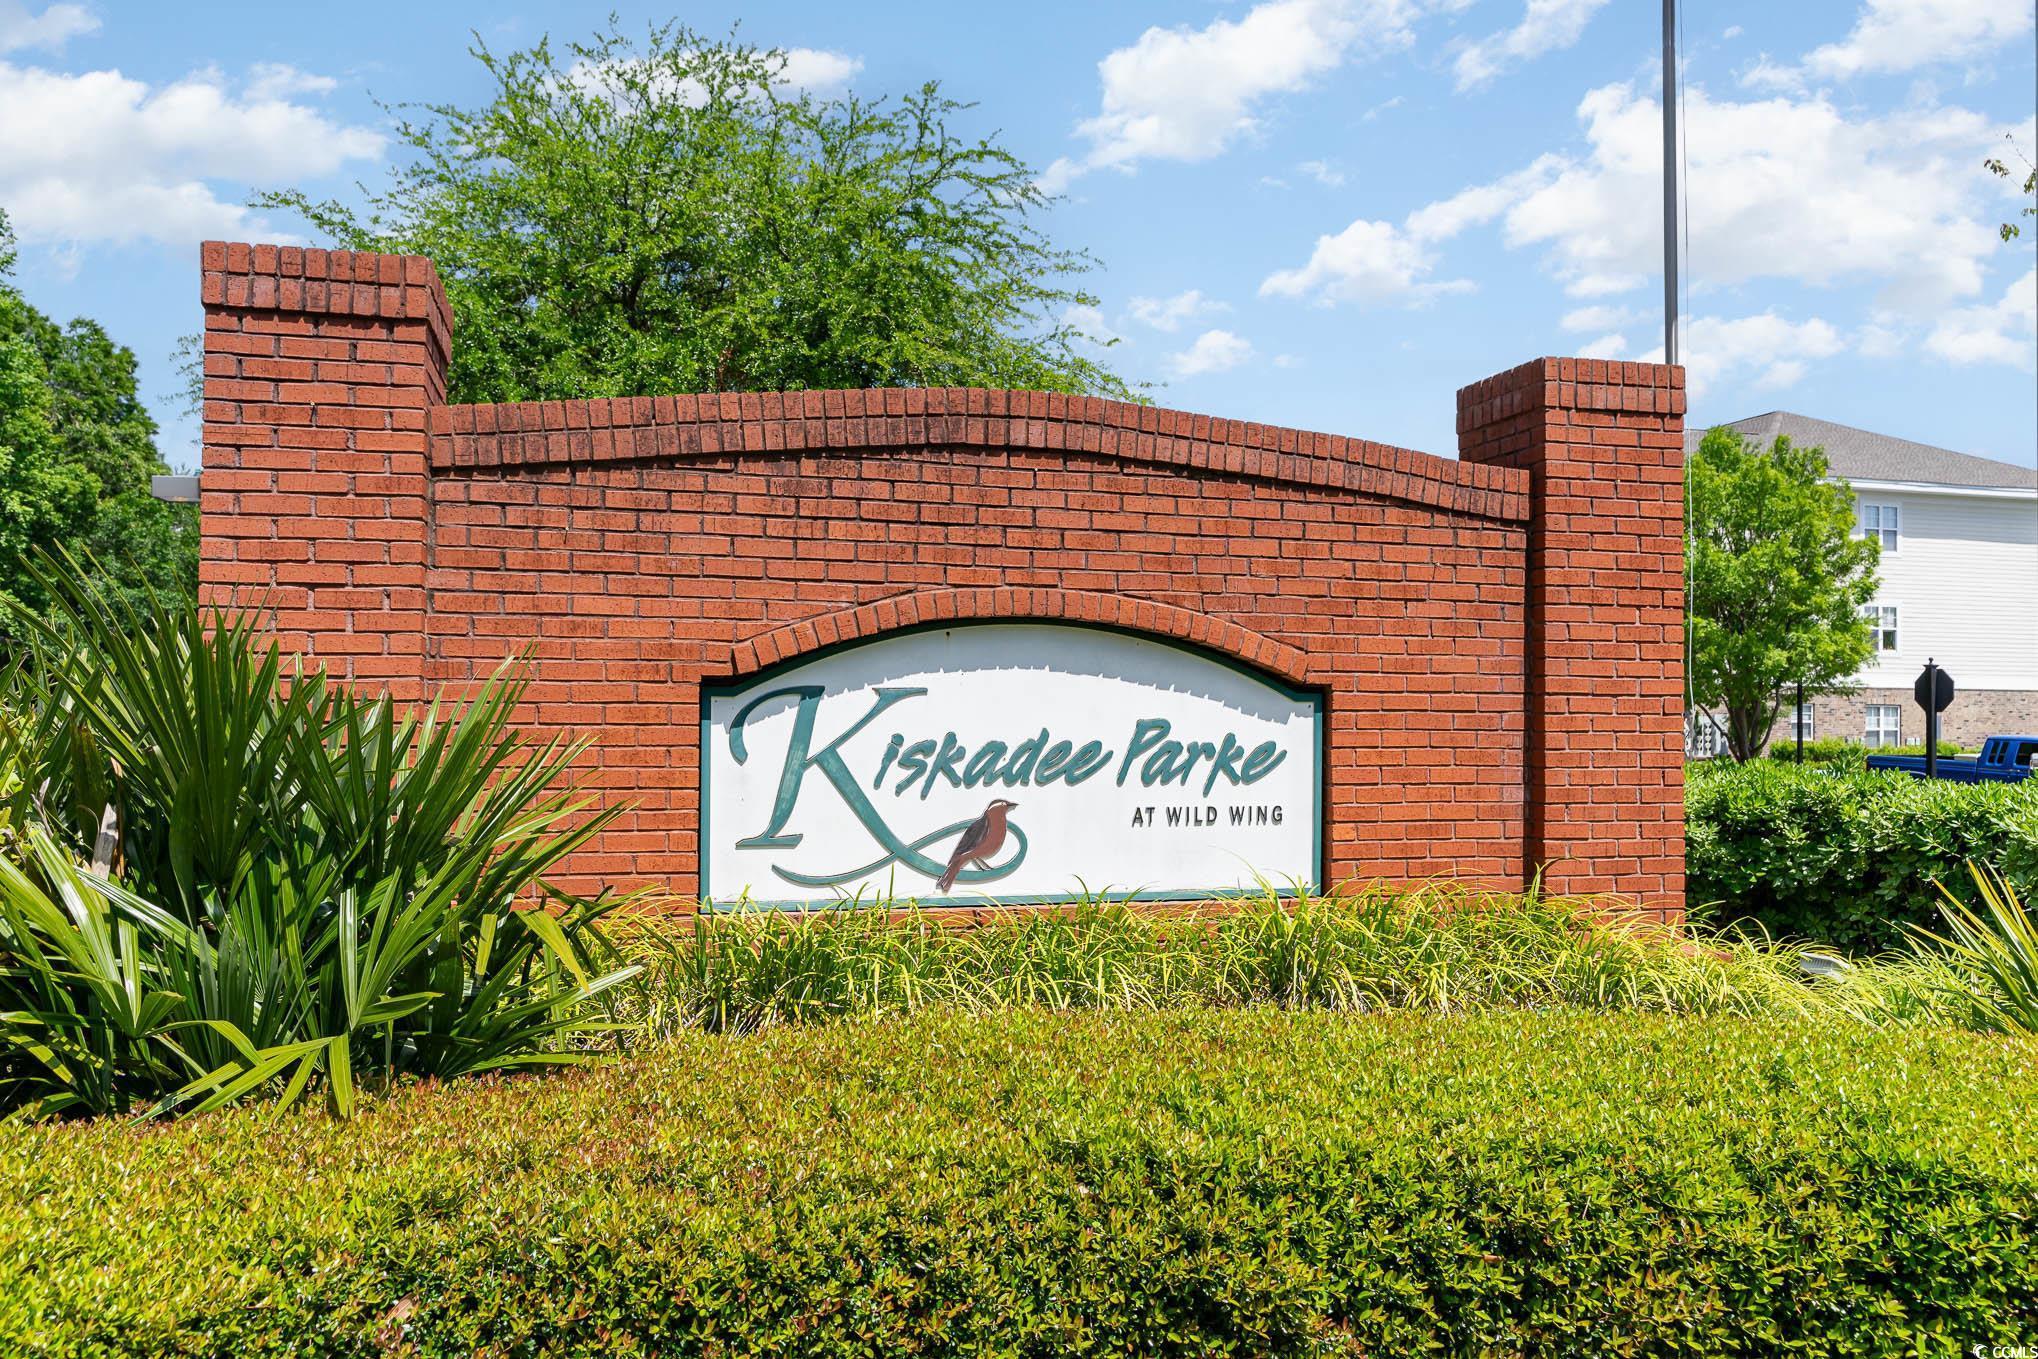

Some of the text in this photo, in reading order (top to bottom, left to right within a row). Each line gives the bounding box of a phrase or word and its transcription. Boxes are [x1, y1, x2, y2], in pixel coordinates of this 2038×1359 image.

[729, 685, 1288, 886] Kiskadee Parke
[1131, 805, 1284, 828] AT WILD WING
